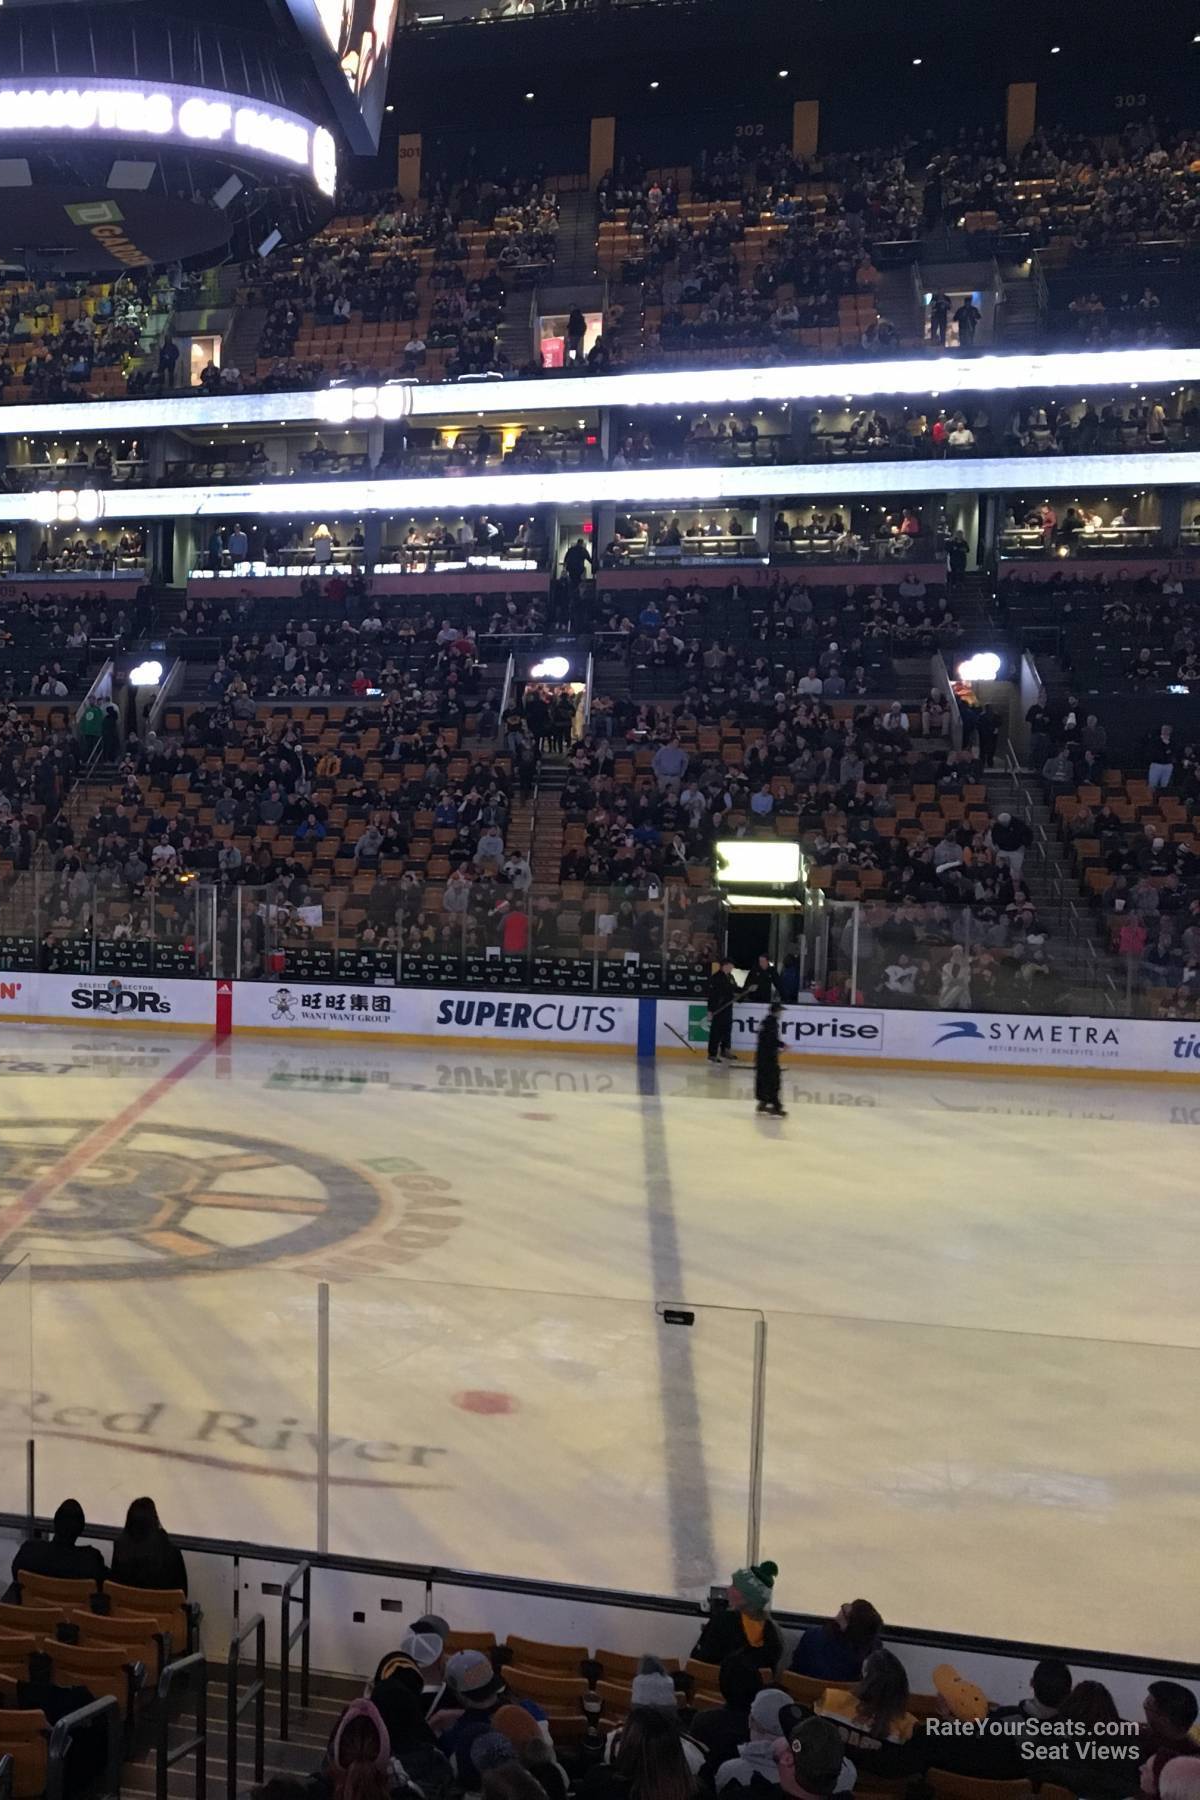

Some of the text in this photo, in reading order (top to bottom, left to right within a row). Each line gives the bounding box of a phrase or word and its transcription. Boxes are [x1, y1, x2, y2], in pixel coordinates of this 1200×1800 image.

[736, 124, 764, 136] 302
[400, 147, 420, 158] 301
[301, 1012, 391, 1023] WANT WANT GROUP
[436, 999, 616, 1033] SUPERCUTS
[989, 1022, 1120, 1046] SYMETRA
[190, 1409, 449, 1467] River
